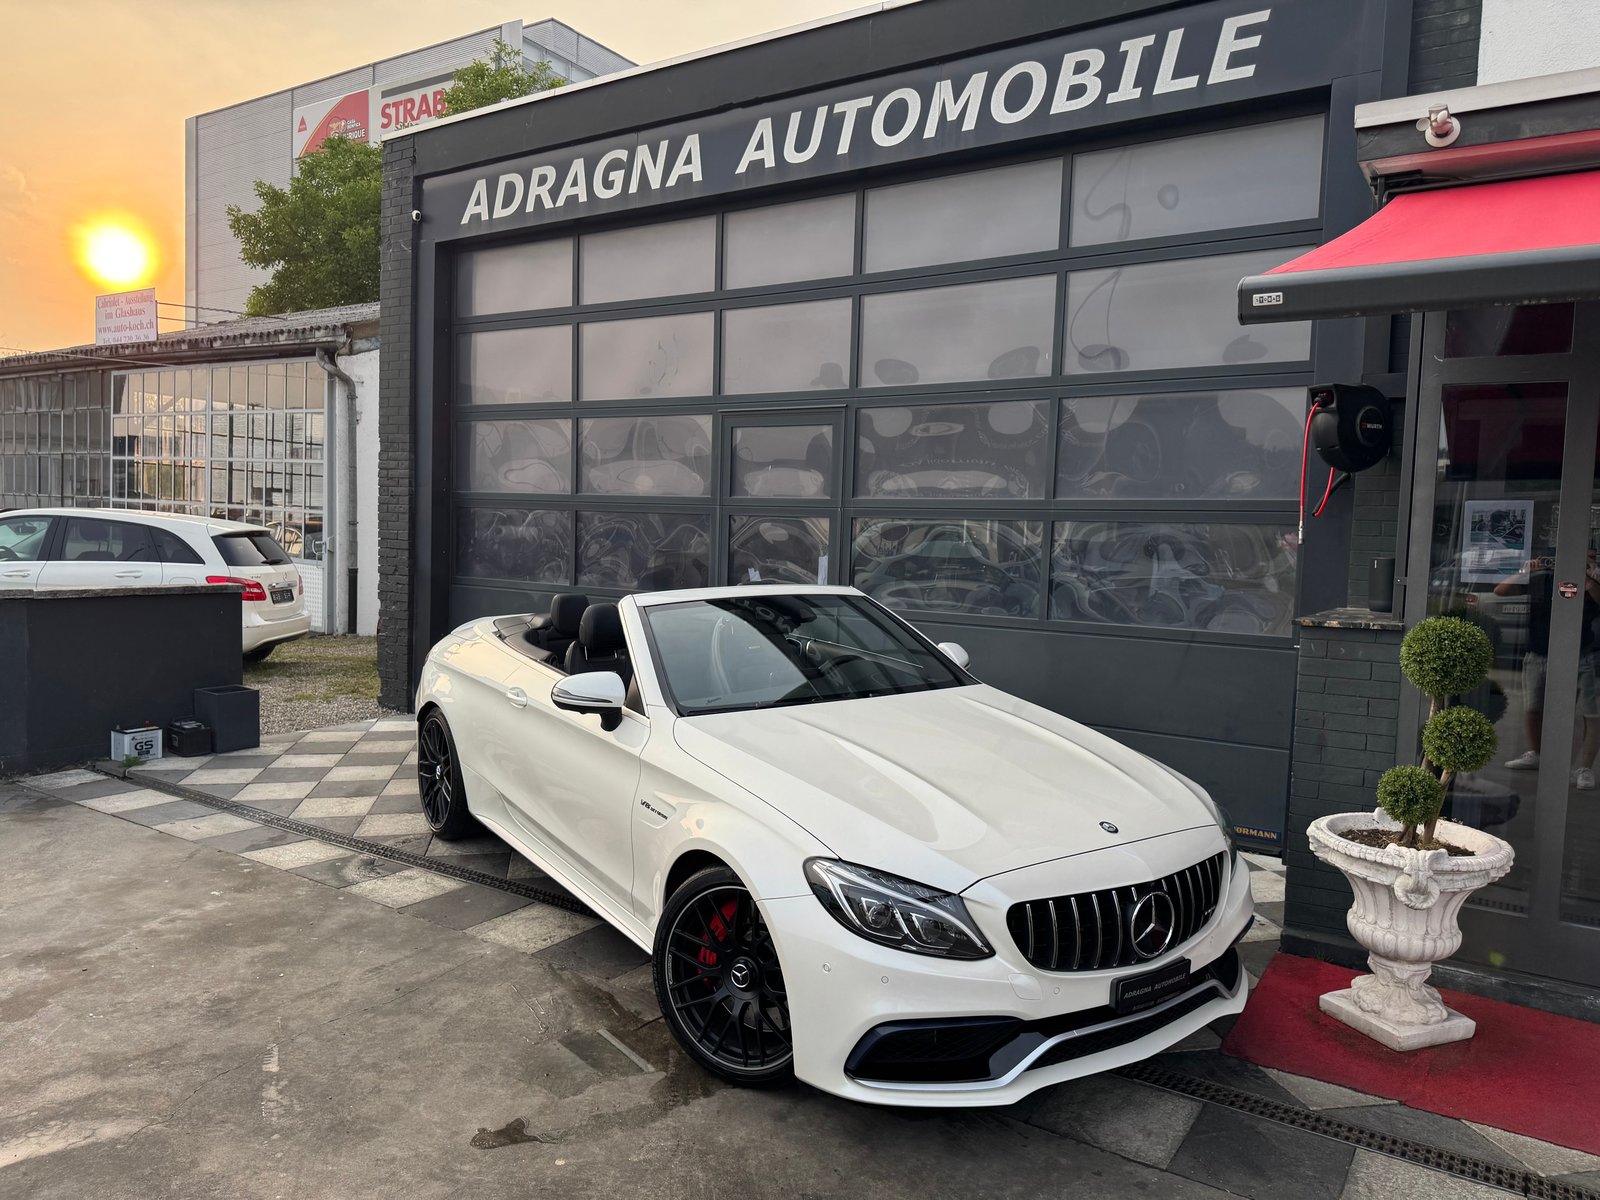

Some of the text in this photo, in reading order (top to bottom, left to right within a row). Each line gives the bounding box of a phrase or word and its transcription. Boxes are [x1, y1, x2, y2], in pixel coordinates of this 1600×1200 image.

[460, 9, 1272, 225] ADRAGNA AUTOMOBILE
[105, 306, 146, 320] im Glashaus
[98, 318, 154, 334] www.auto-koch.ch
[134, 740, 154, 751] GS
[1124, 972, 1186, 999] ADRAGNA AUTOMOBILE
